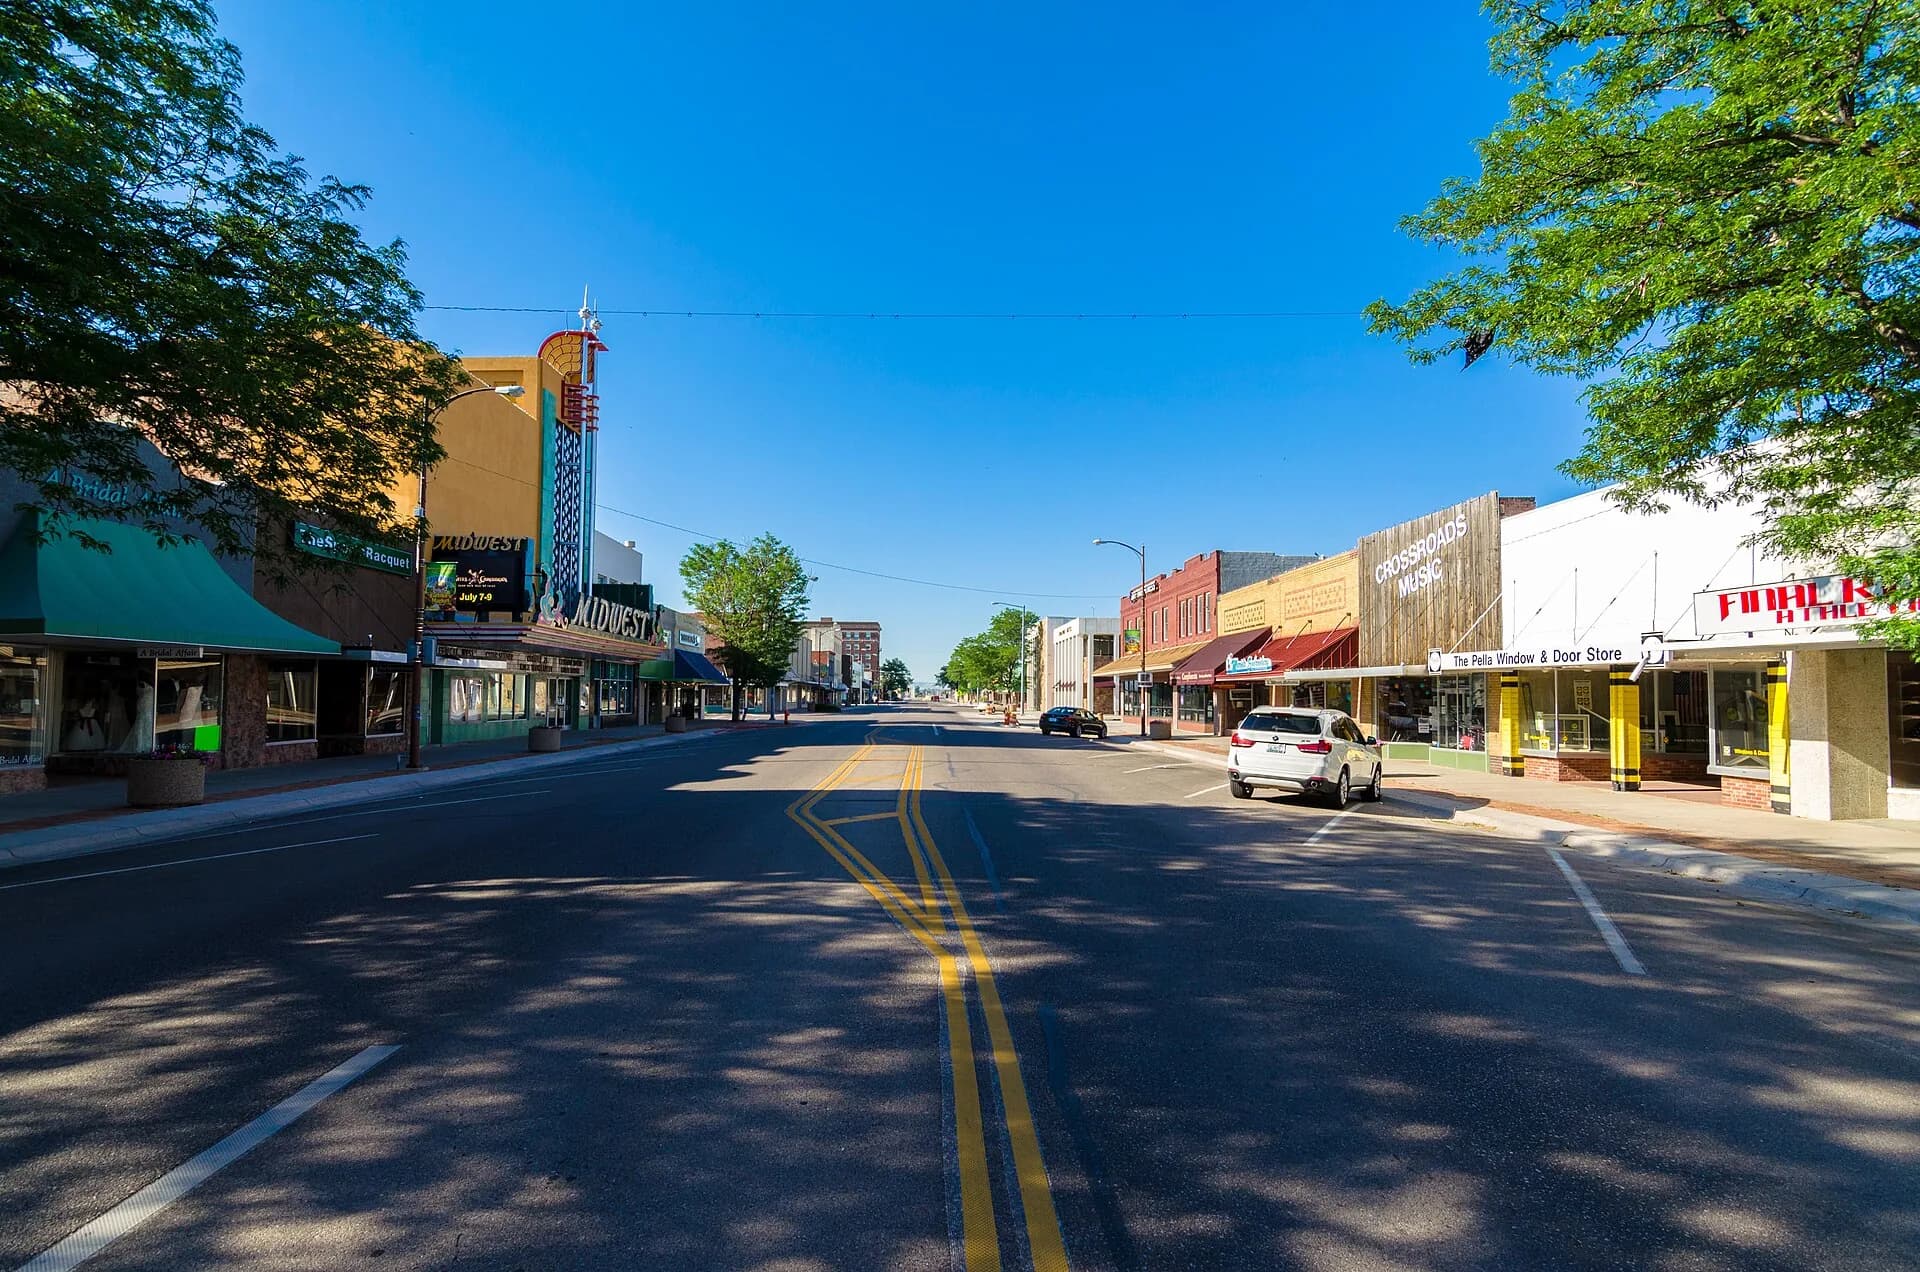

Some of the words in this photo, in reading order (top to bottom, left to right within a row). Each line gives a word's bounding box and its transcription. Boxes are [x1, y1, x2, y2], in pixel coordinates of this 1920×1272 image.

[46, 468, 60, 484] A
[71, 474, 130, 506] Bridal
[432, 535, 527, 552] MIDWEST
[1375, 514, 1467, 585] CROSSROADS
[1398, 557, 1443, 598] MUSIC
[459, 593, 478, 603] July
[479, 592, 493, 602] 7-9
[572, 591, 651, 640] MIDWEST
[1718, 582, 1835, 622] FINAL
[139, 648, 147, 657] A
[150, 647, 172, 657] Bridal
[175, 648, 198, 658] Affair
[1454, 655, 1469, 668] The
[1472, 653, 1493, 666] Pella
[1496, 650, 1535, 665] Window
[1540, 650, 1548, 663] &
[1553, 649, 1582, 663] Door
[1586, 646, 1622, 661] Store
